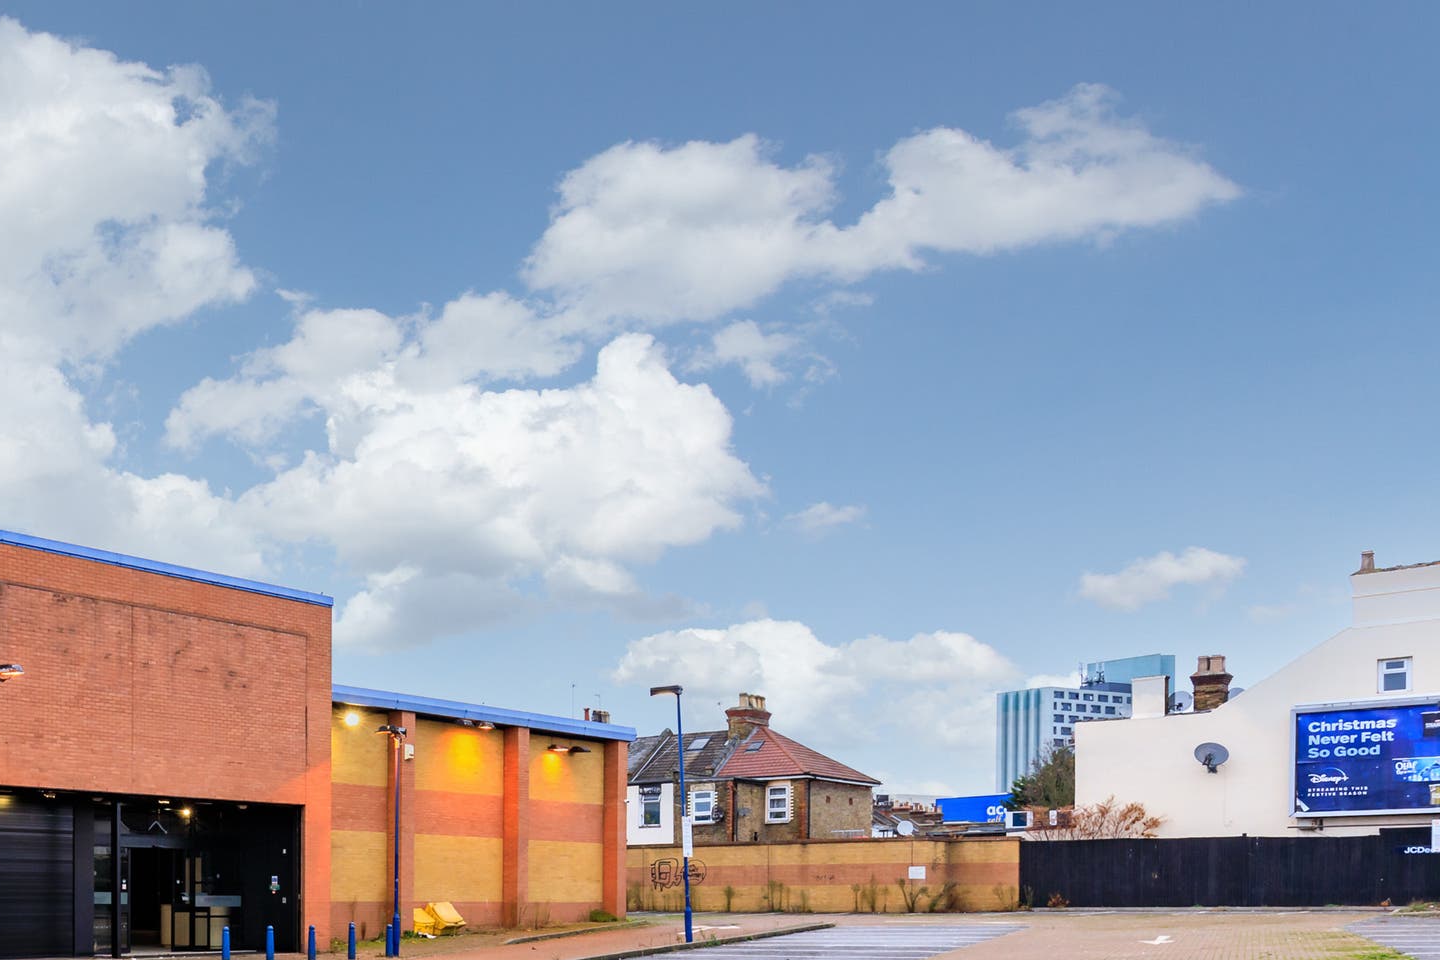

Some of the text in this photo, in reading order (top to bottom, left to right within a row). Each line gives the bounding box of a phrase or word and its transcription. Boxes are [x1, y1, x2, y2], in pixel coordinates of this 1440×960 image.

[1308, 719, 1397, 732] Christmas
[1308, 731, 1395, 745] Never Felt
[1308, 745, 1380, 758] So Good
